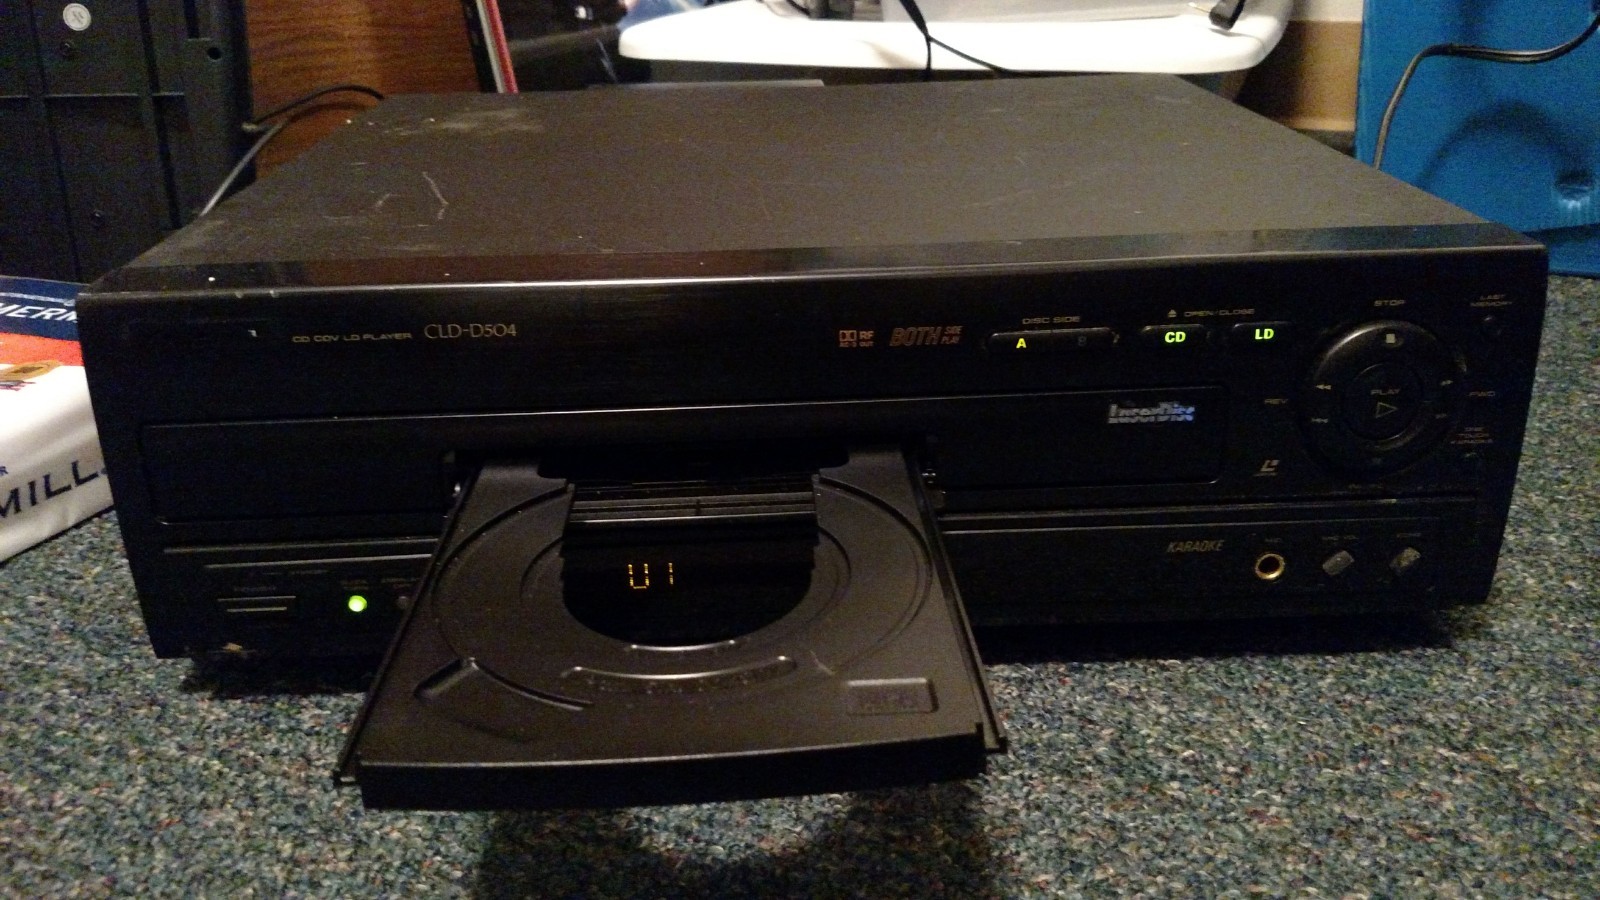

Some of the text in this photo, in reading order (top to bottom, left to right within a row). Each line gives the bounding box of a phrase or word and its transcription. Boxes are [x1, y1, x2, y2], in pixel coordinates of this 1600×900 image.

[1374, 299, 1406, 307] STOP
[1021, 316, 1081, 325] DISC SIDE
[291, 335, 311, 343] CD
[342, 334, 361, 342] LD
[362, 331, 413, 341] PLAYER
[423, 323, 518, 340] CLD-D504
[858, 330, 875, 340] RF
[888, 326, 942, 347] BOTH
[1164, 331, 1186, 344] CD
[1254, 328, 1275, 341] LD
[1015, 338, 1027, 349] A
[1370, 388, 1401, 396] PLAY
[1167, 539, 1226, 553] KARAOKE
